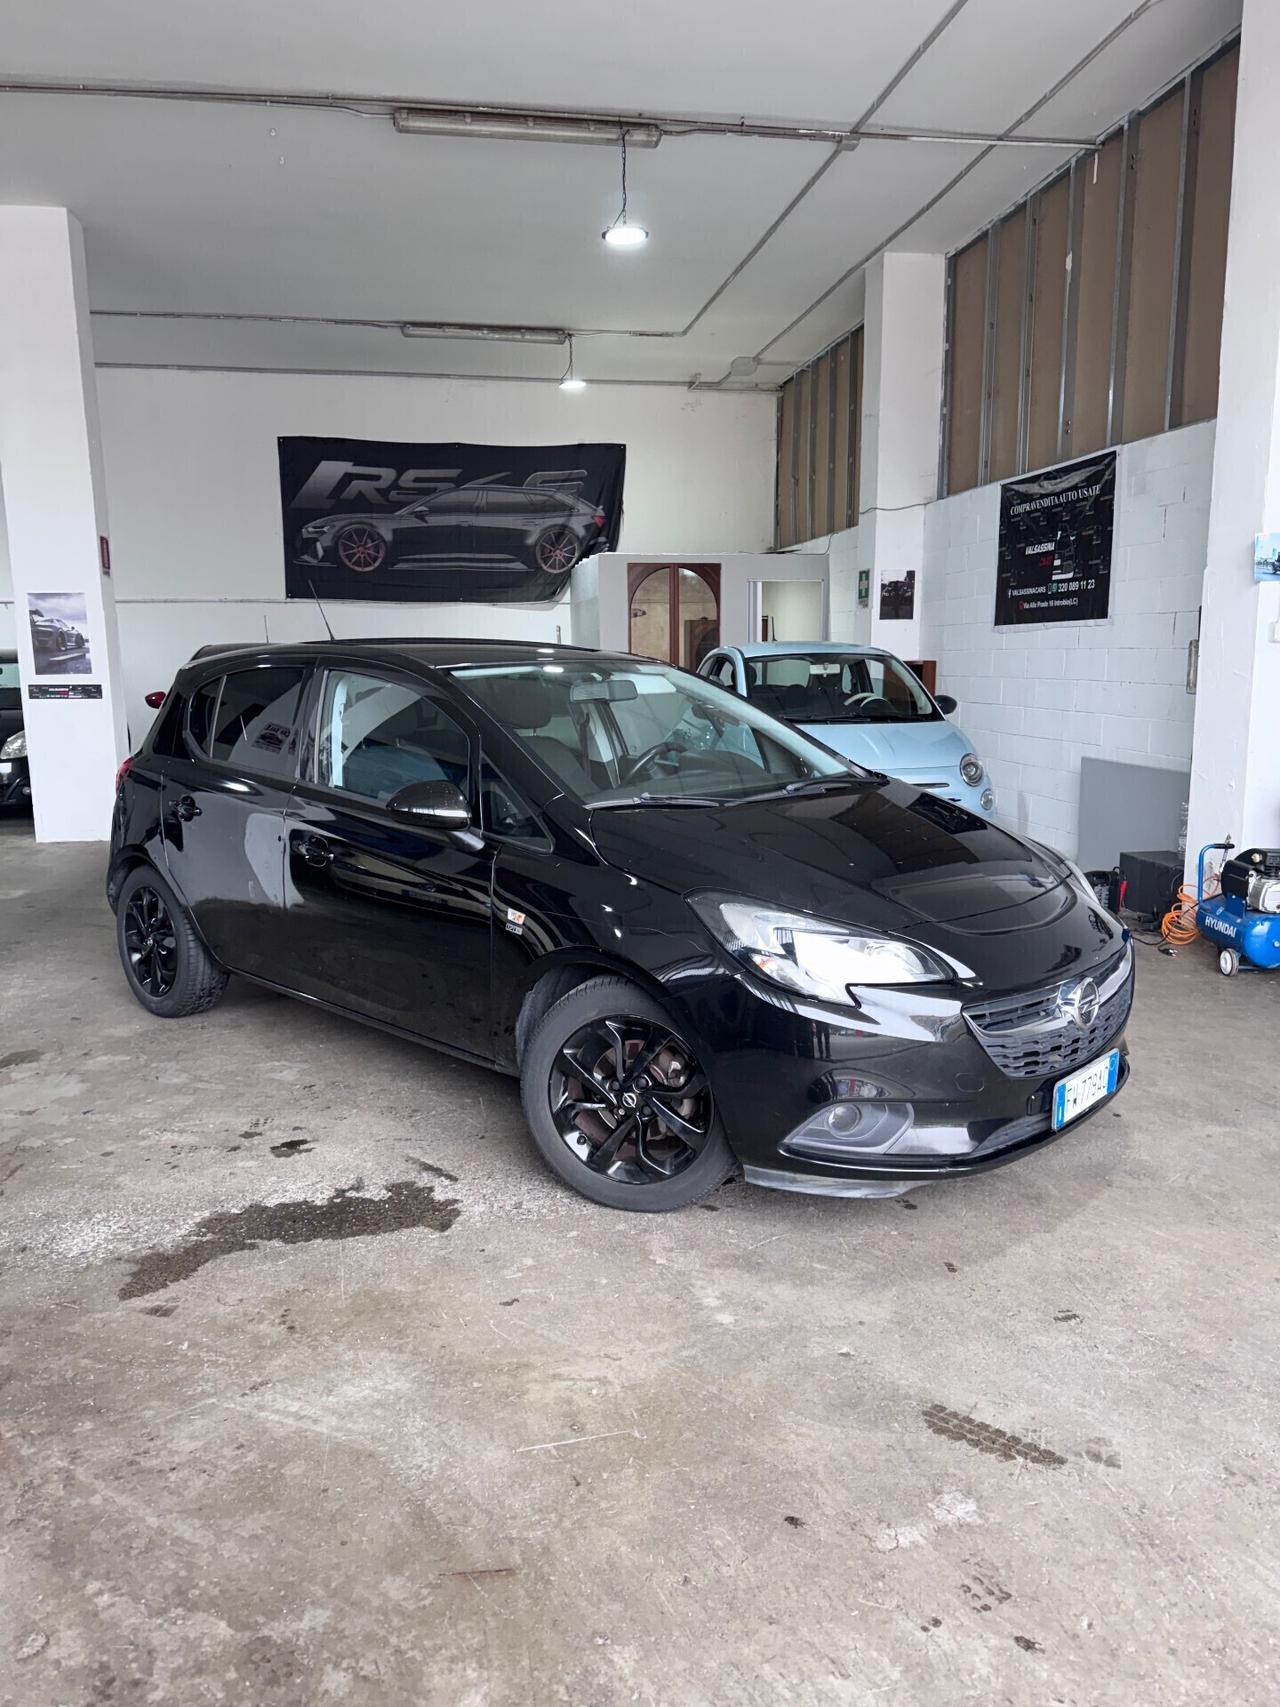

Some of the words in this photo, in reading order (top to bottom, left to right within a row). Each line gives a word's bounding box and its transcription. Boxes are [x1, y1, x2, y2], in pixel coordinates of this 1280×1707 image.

[1010, 495, 1058, 515] COMPRAVENDITA
[1058, 490, 1077, 505] AUTO
[1079, 484, 1101, 499] USATE
[1025, 541, 1056, 555] VALSASSINA
[1058, 582, 1068, 592] 320
[1069, 581, 1079, 591] 089
[1080, 579, 1086, 590] 11
[1087, 578, 1095, 589] 23
[1205, 915, 1237, 938] HYUNDAI
